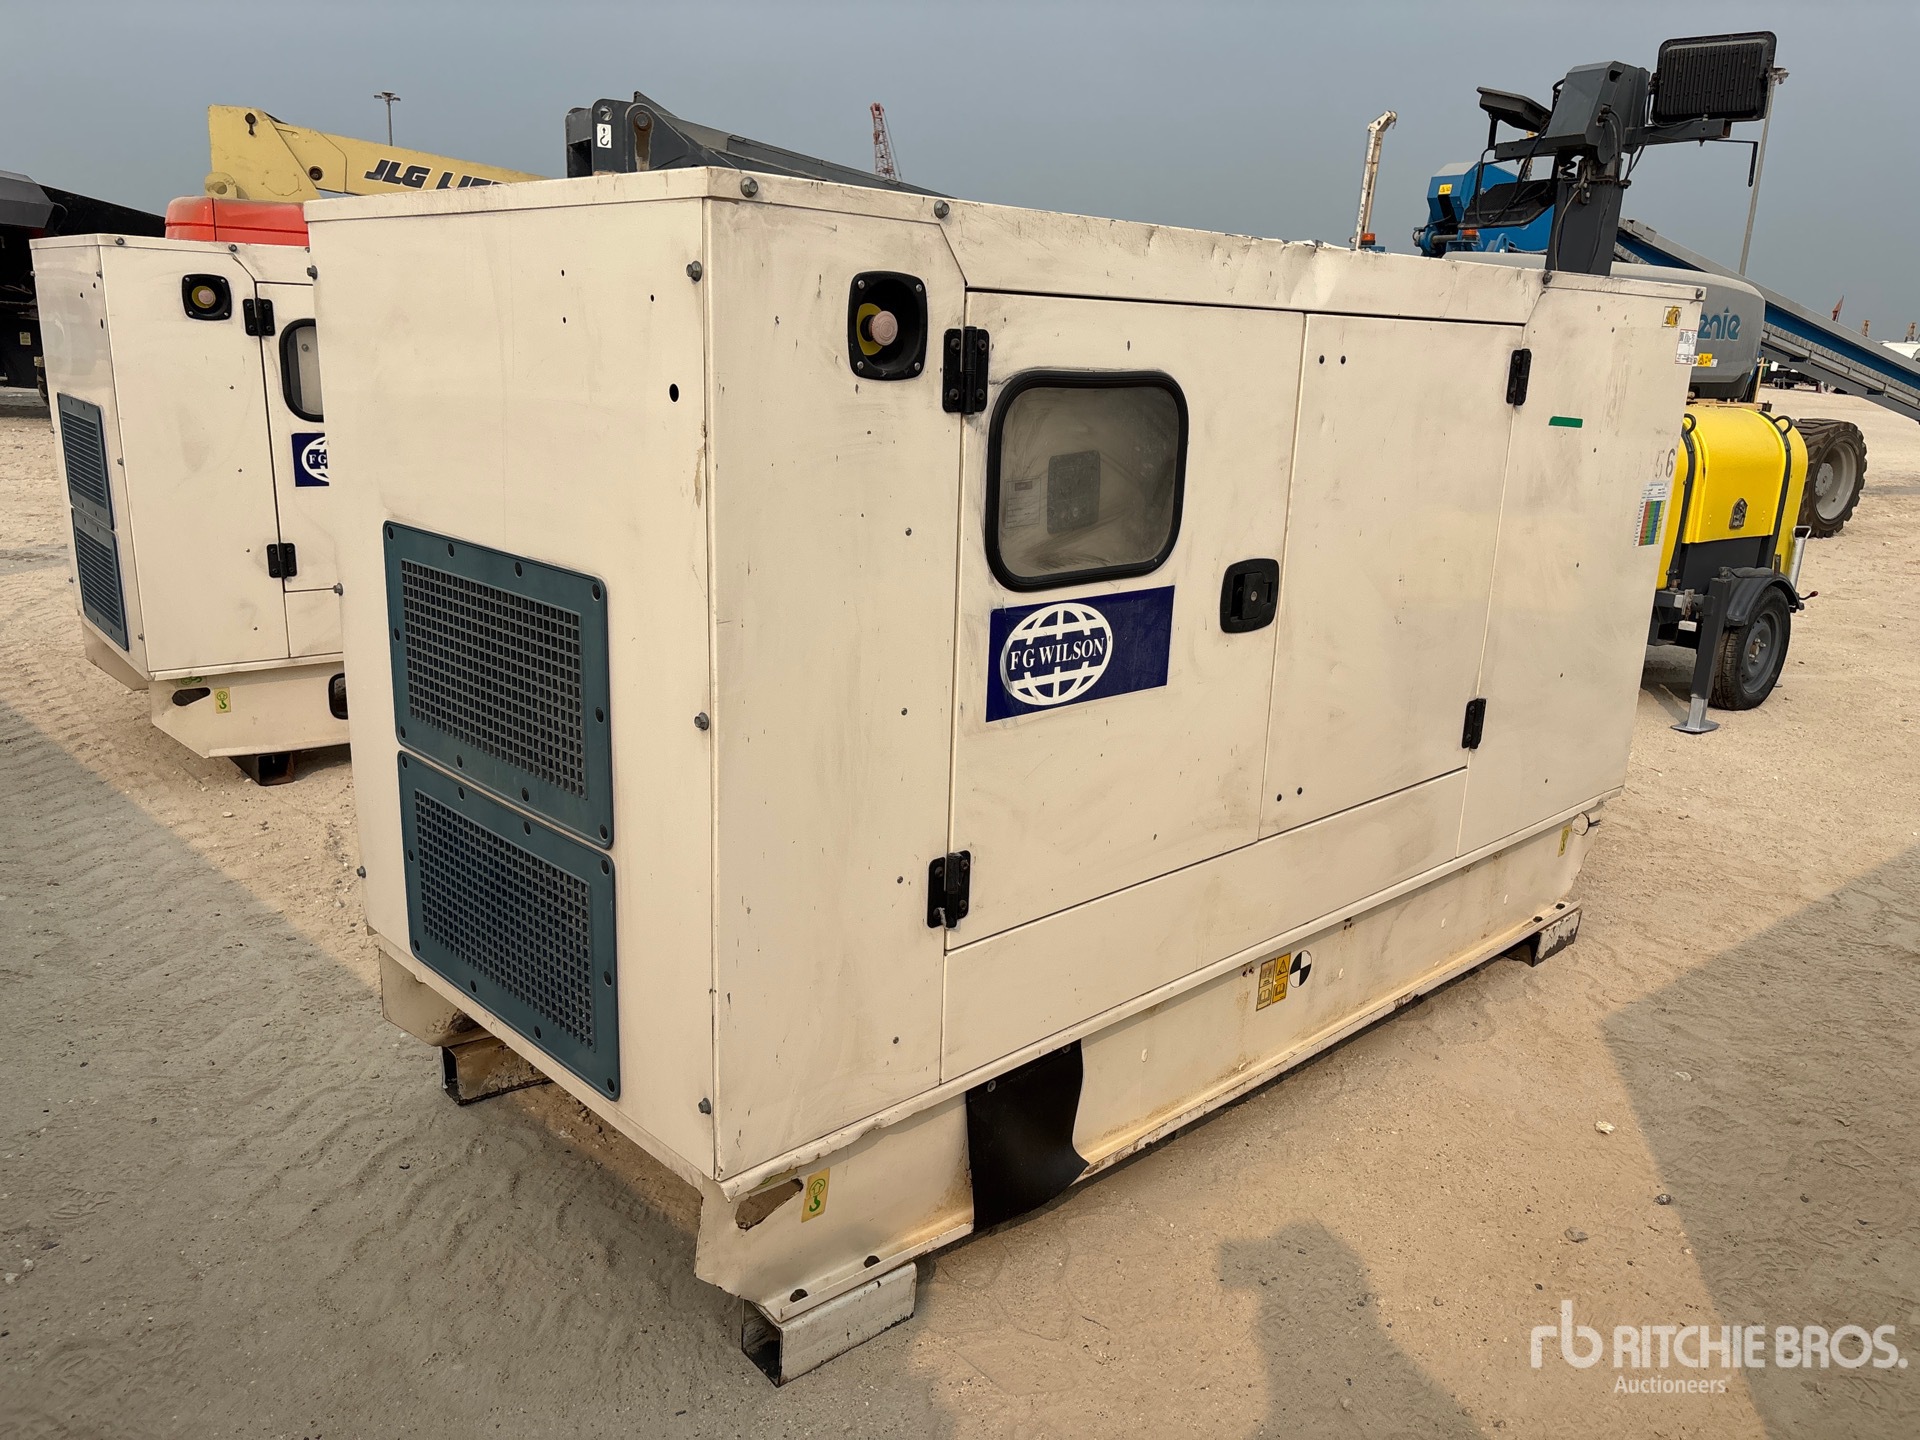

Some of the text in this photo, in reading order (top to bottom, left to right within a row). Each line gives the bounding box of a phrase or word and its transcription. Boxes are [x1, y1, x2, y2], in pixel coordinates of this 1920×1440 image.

[363, 159, 503, 190] JLG LI
[1697, 307, 1741, 340] enie
[309, 454, 327, 465] FG
[1009, 637, 1105, 671] FG WILSON
